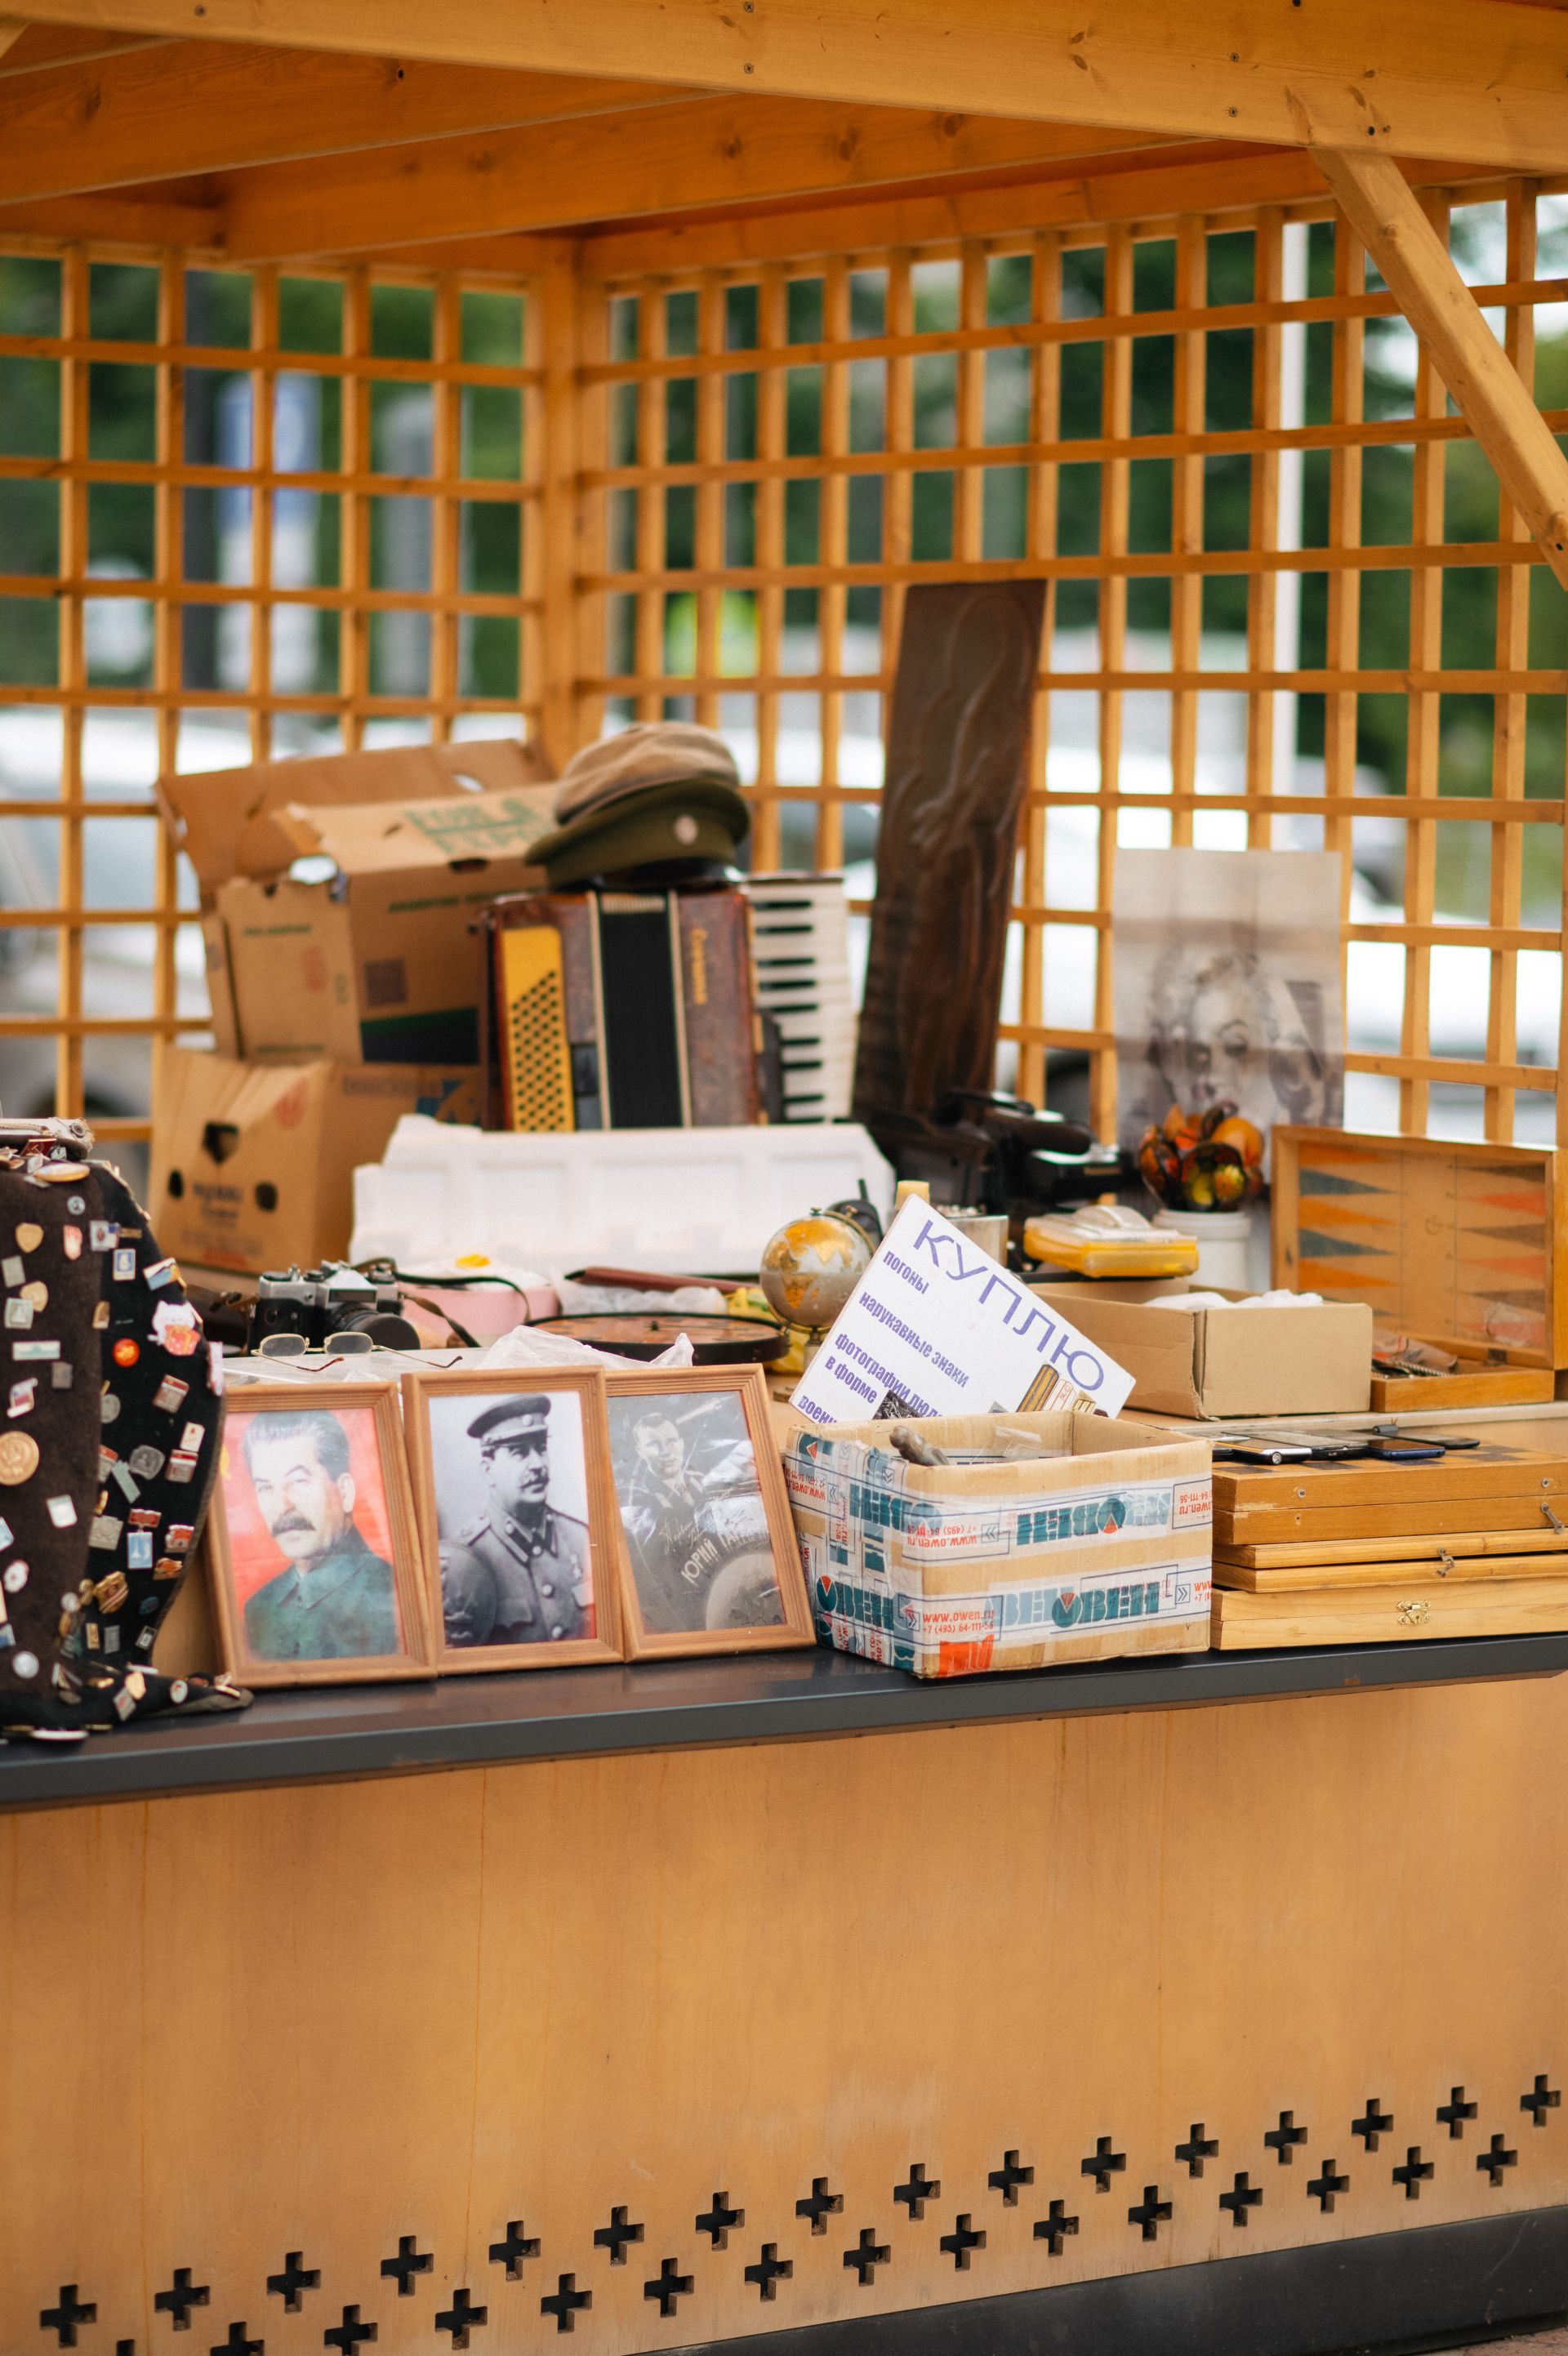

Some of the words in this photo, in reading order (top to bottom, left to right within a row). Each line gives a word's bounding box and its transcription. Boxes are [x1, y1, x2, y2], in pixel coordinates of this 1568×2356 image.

[883, 1251, 929, 1294] погоны
[913, 1219, 1104, 1391] КУПЛЮ
[859, 1292, 933, 1357] нарукавные
[932, 1352, 970, 1388] знаки
[825, 1356, 836, 1370] в
[835, 1363, 878, 1404] форме
[835, 1333, 911, 1401] фотографии
[908, 1393, 943, 1417] люд
[798, 1395, 838, 1423] воен
[907, 1535, 977, 1548] www.owen.ru
[923, 1610, 994, 1623] www.owen.ru
[923, 1625, 932, 1633] +7
[934, 1624, 956, 1634] (495)
[959, 1621, 994, 1632] 64-111-56
